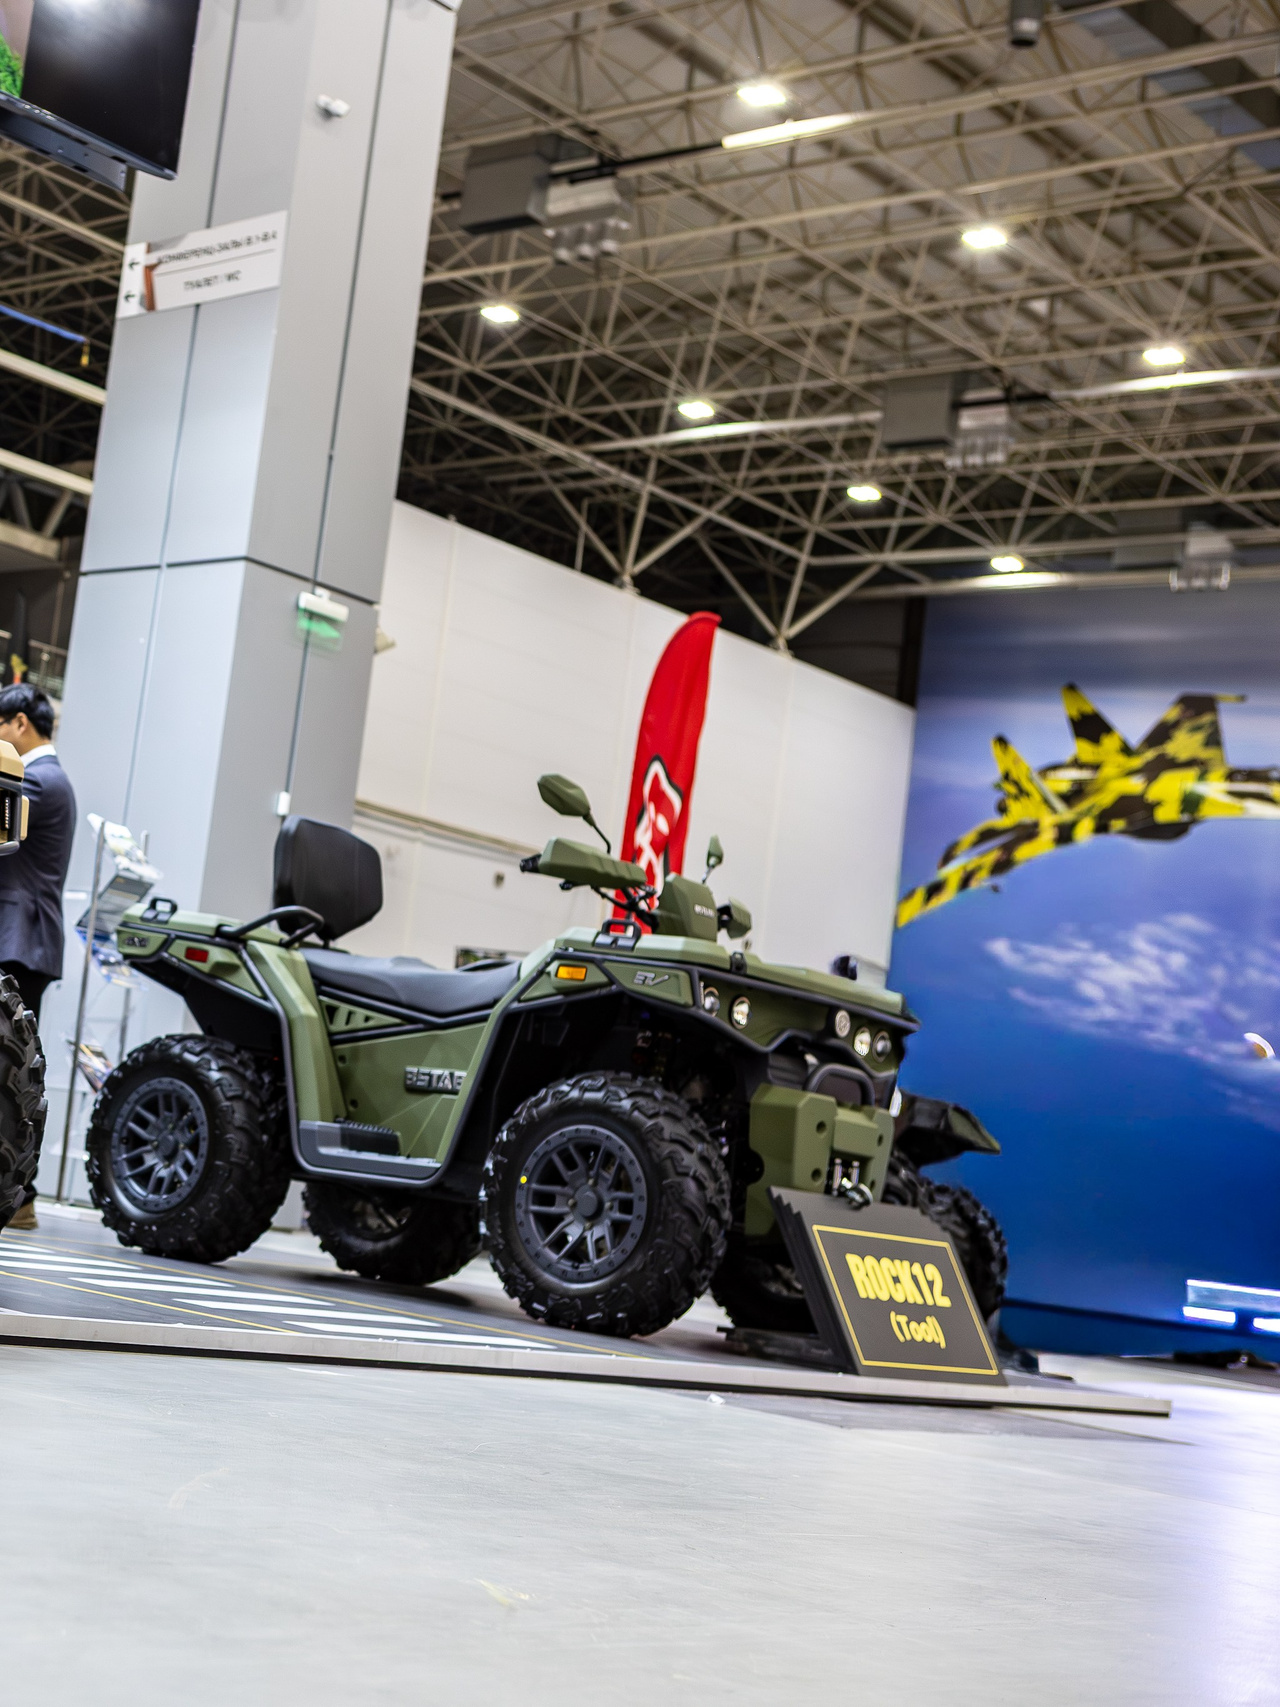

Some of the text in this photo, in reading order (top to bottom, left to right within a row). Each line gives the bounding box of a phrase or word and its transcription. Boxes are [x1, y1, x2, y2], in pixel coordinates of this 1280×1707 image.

[405, 1067, 467, 1090] BSTAB
[845, 1252, 952, 1308] ROCK12
[889, 1310, 946, 1349] (Tool)
